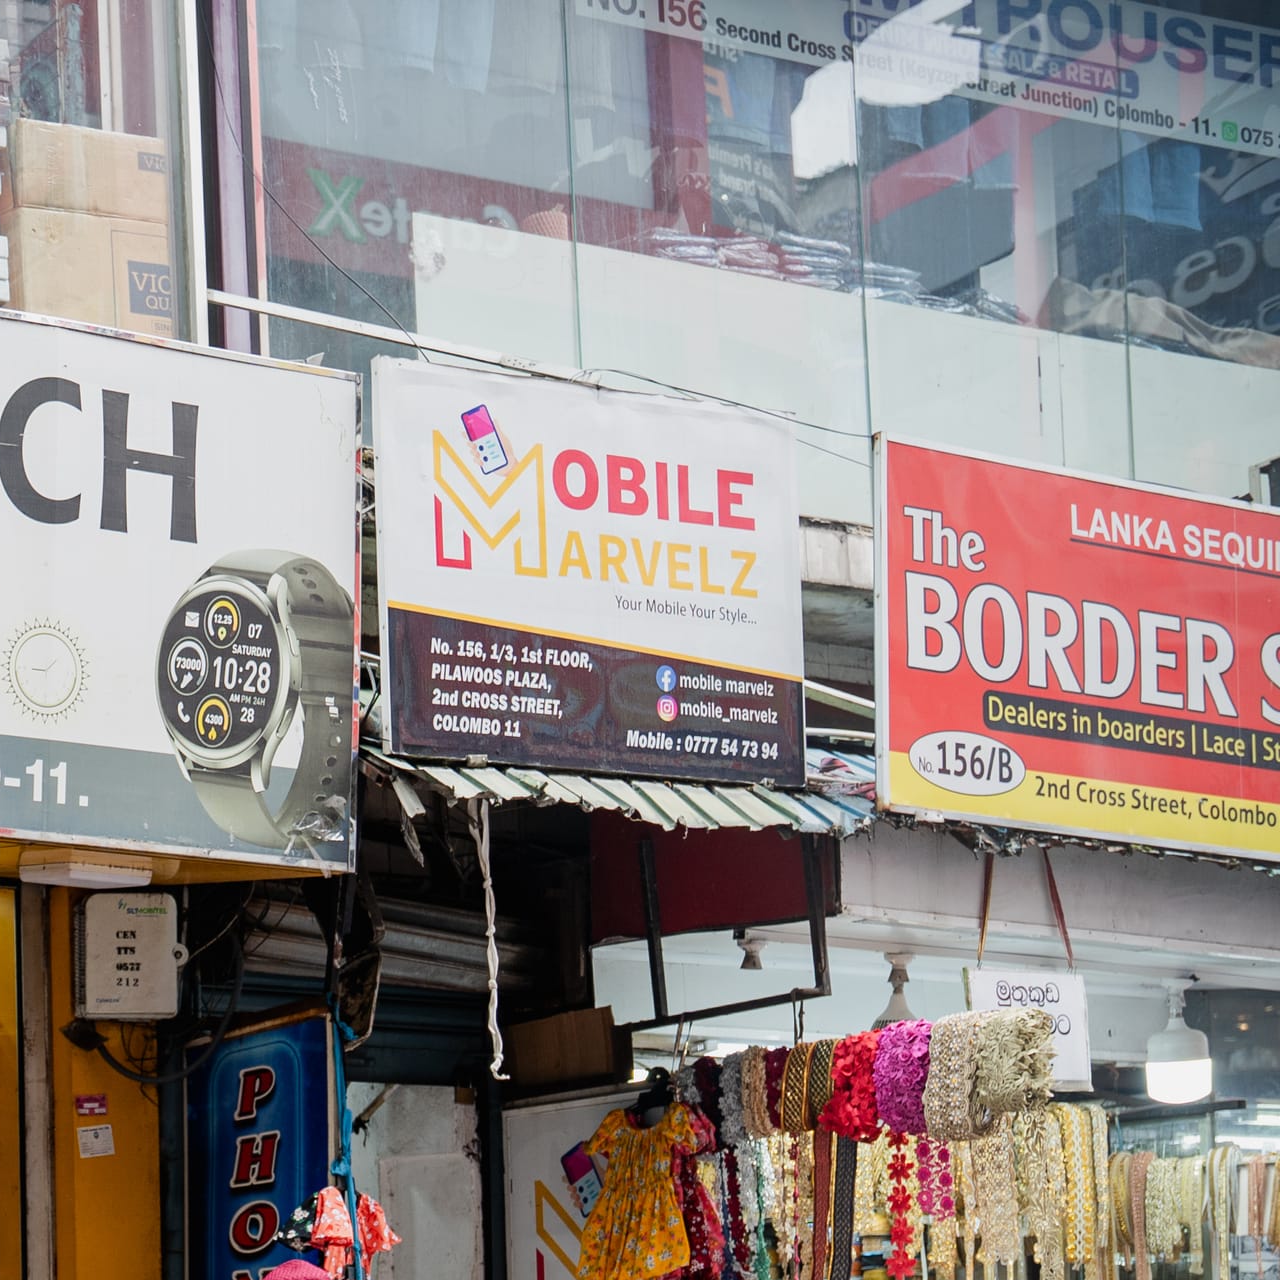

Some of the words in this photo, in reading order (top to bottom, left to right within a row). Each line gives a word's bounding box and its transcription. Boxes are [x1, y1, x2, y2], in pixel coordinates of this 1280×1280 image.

[716, 17, 782, 48] Second
[787, 33, 837, 60] Cross
[1020, 84, 1099, 118] Junction)
[1105, 99, 1174, 131] Colombo
[1066, 64, 1132, 94] RETAIL
[903, 505, 985, 572] The
[1070, 504, 1176, 553] LANKA
[615, 595, 642, 612] Your
[646, 598, 687, 618] Mobile
[689, 603, 716, 619] Your
[720, 606, 758, 625] Style...
[248, 623, 262, 639] 07
[905, 571, 1239, 718] BORDER
[176, 656, 202, 671] 73000
[232, 643, 272, 658] SATURDAY
[431, 638, 453, 656] No.
[458, 640, 487, 661] 156,
[491, 643, 516, 664] 1/3,
[521, 647, 542, 665] 1st
[546, 650, 593, 672] FLOOR,
[213, 656, 271, 693] 10:28
[431, 664, 502, 686] PILAWOOS
[505, 671, 552, 693] PLAZA,
[679, 675, 722, 693] mobile
[726, 679, 774, 698] marvelz
[240, 707, 255, 723] 28
[432, 689, 458, 707] 2nd
[462, 693, 507, 712] CROSS
[511, 697, 564, 719] STREET,
[679, 700, 778, 725] mobile_marvelz
[433, 714, 501, 736] COLOMBO
[505, 720, 521, 738] 11
[988, 695, 1067, 733] Dealers
[1072, 707, 1091, 735] in
[1098, 711, 1185, 750] boarders
[1202, 727, 1245, 757] Lace
[626, 730, 673, 751] Mobile
[684, 736, 718, 755] 0777
[721, 737, 738, 756] 54
[741, 739, 758, 758] 73
[761, 741, 778, 761] 94
[918, 755, 934, 774] No.
[937, 740, 1013, 784] 156/B
[1035, 776, 1069, 801] 2nd
[1076, 781, 1126, 808] Cross
[1131, 785, 1192, 820] Street,
[1198, 797, 1278, 828] Colombo
